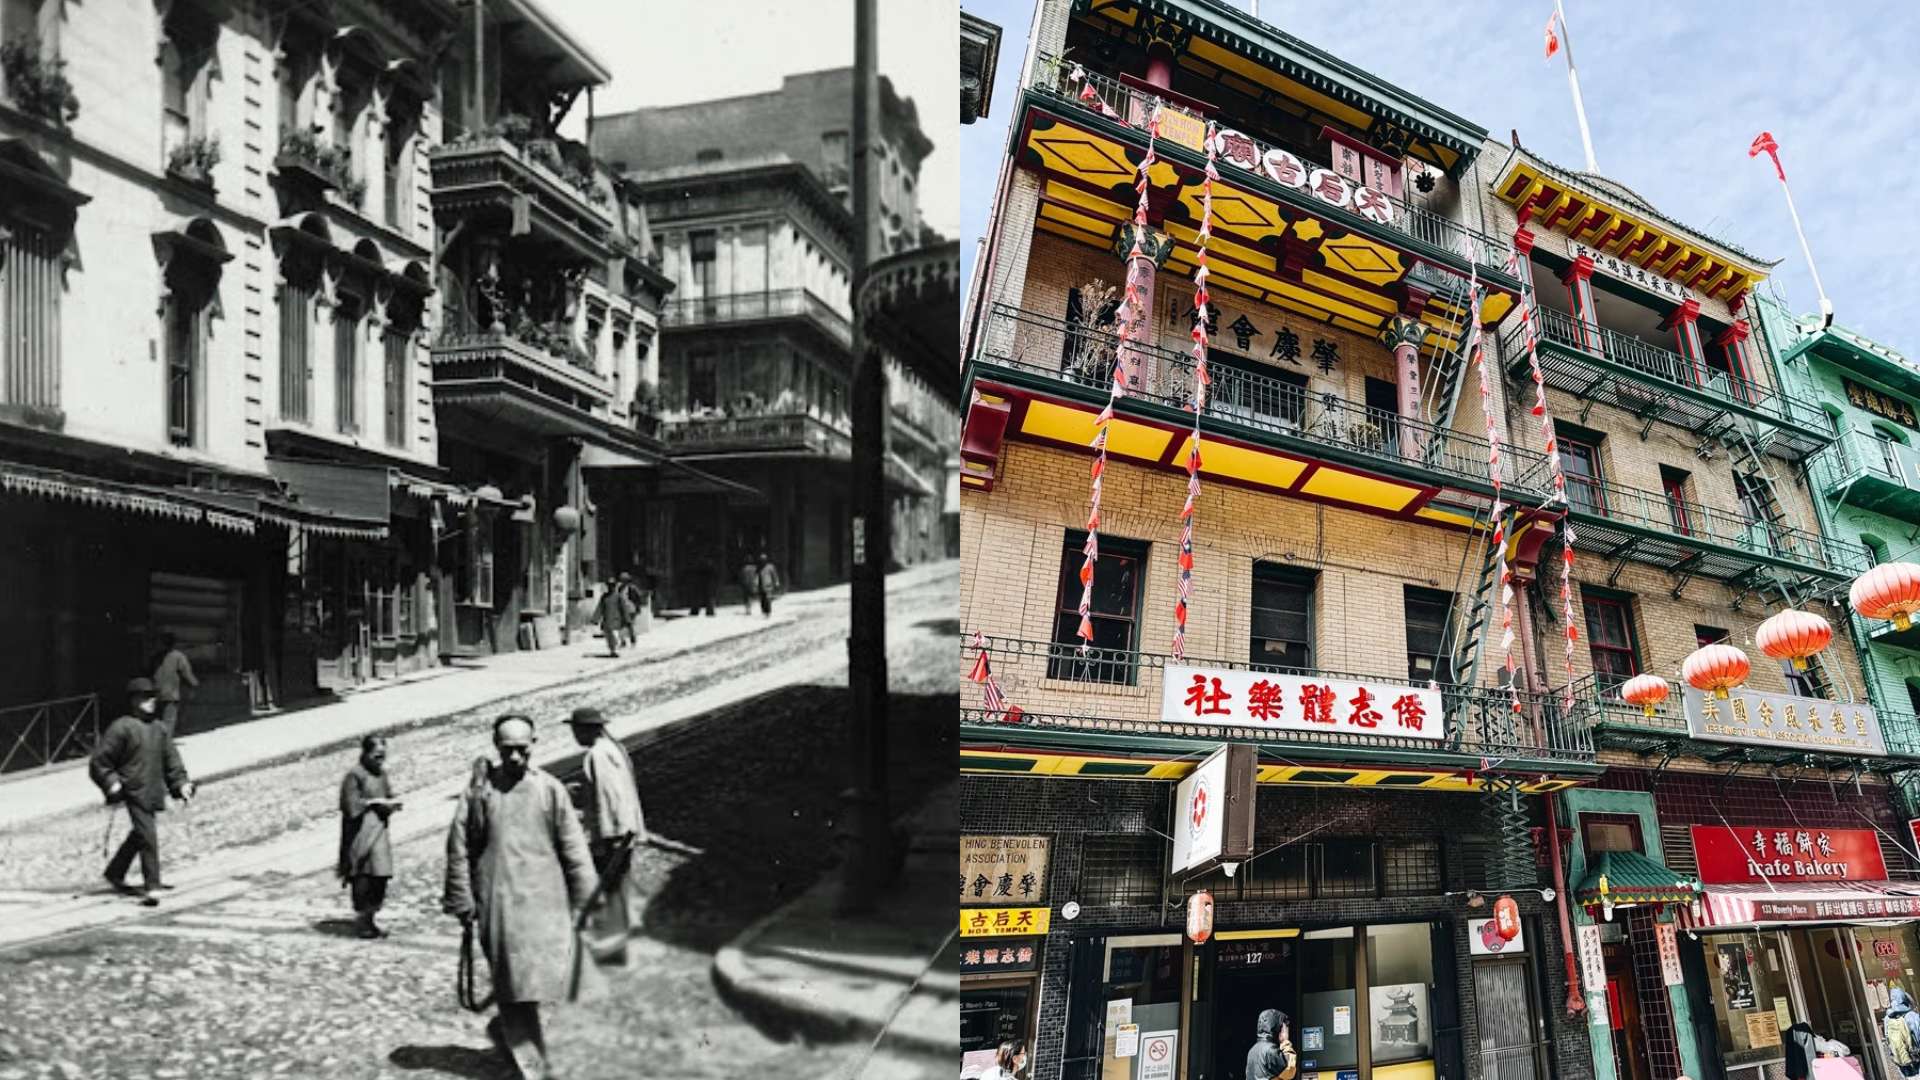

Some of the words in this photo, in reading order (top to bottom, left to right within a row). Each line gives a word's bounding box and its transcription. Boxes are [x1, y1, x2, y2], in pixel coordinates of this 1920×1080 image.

[965, 839, 986, 849] HING
[990, 839, 1050, 849] BENEVOLENT
[1752, 830, 1836, 858] 幸福餅家
[965, 853, 1026, 864] ASSOCIATION
[1794, 859, 1848, 878] Bakery
[1793, 904, 1807, 914] Place
[1876, 943, 1897, 955] OPEN
[960, 946, 1033, 965] 僑志體樂
[1246, 952, 1262, 964] 127
